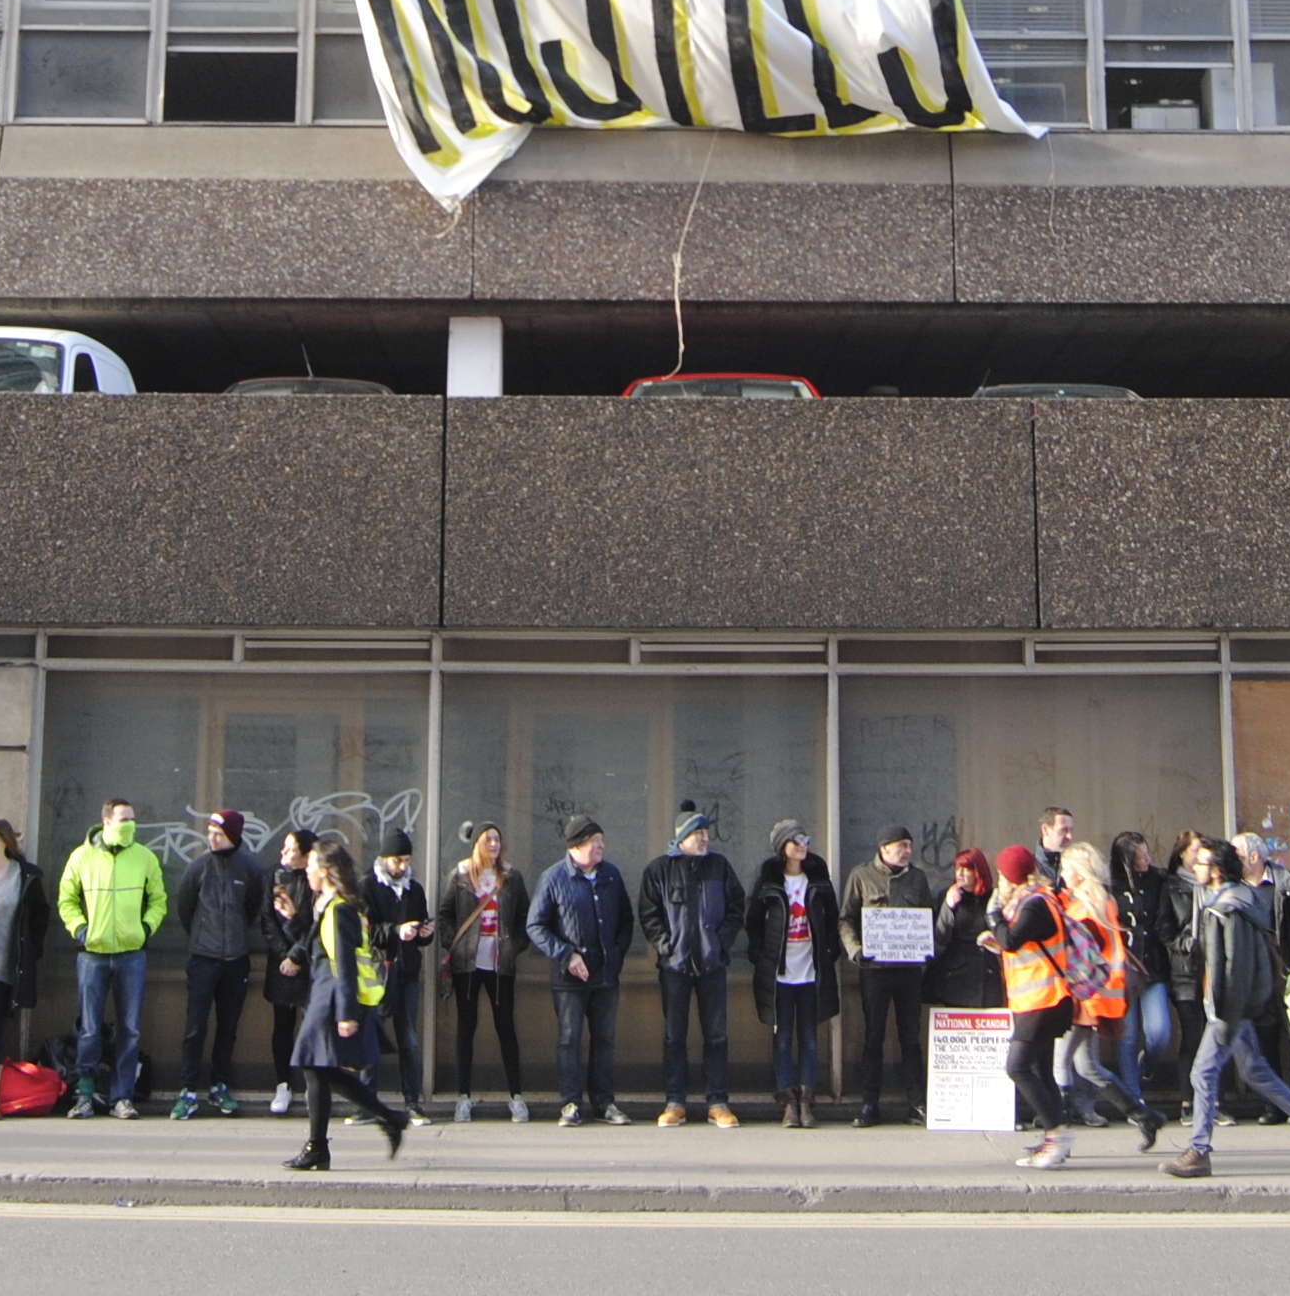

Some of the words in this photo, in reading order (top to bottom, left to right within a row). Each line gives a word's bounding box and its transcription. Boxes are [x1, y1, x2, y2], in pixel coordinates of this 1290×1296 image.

[935, 1018, 973, 1029] NATIONAL
[975, 1018, 1009, 1029] SCANDAL
[970, 1036, 999, 1045] PEOPLE
